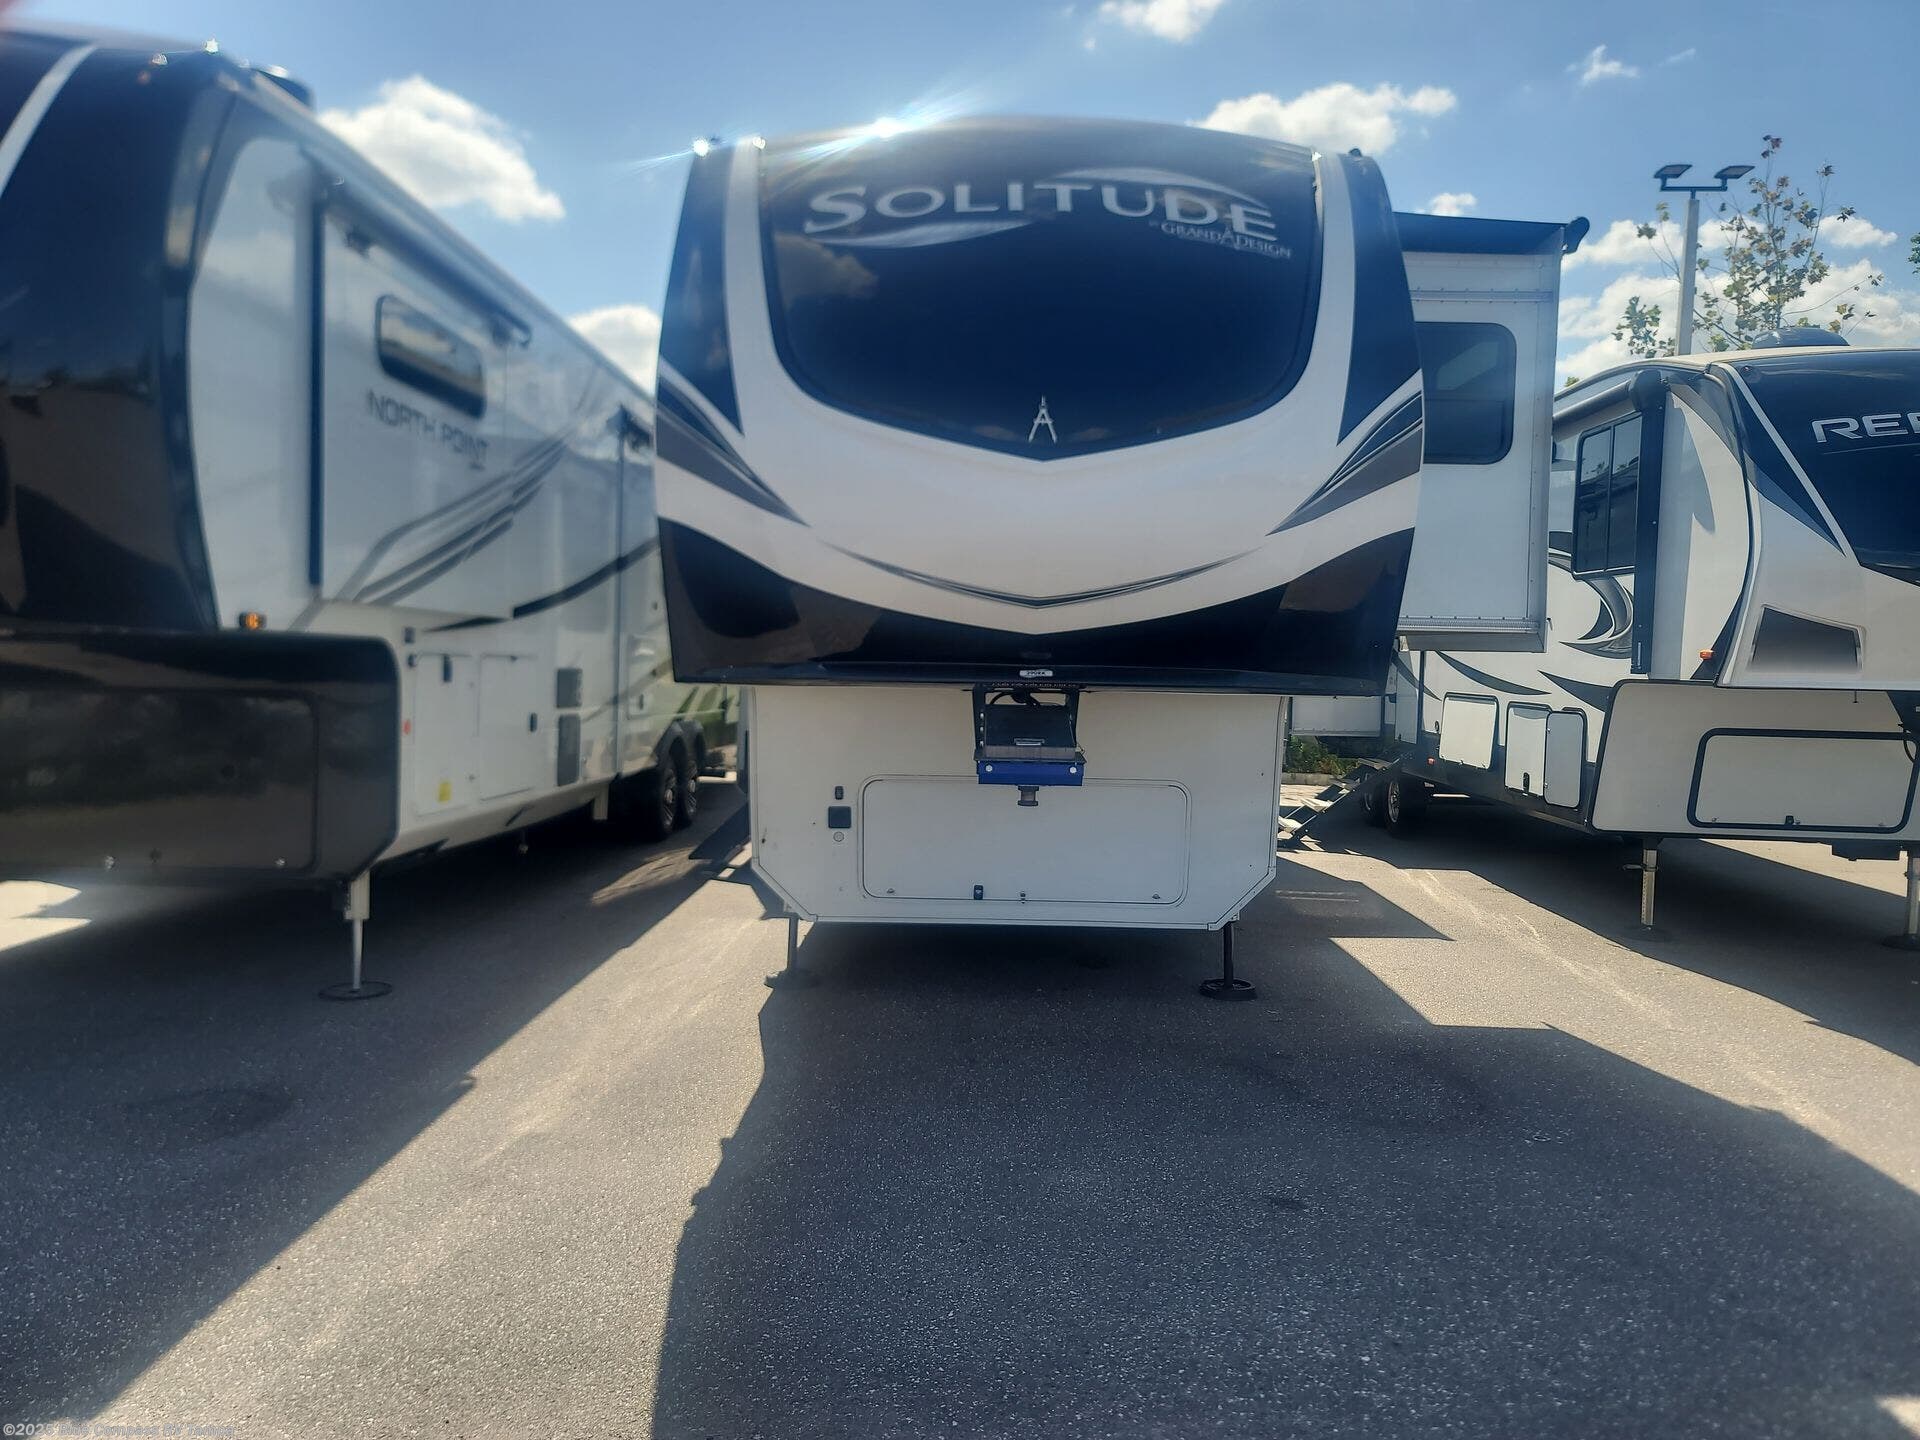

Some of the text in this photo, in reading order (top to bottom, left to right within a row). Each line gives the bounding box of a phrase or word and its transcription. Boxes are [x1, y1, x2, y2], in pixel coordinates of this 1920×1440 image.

[804, 181, 1277, 241] SOLITUDE
[367, 388, 488, 464] NORTH POINT
